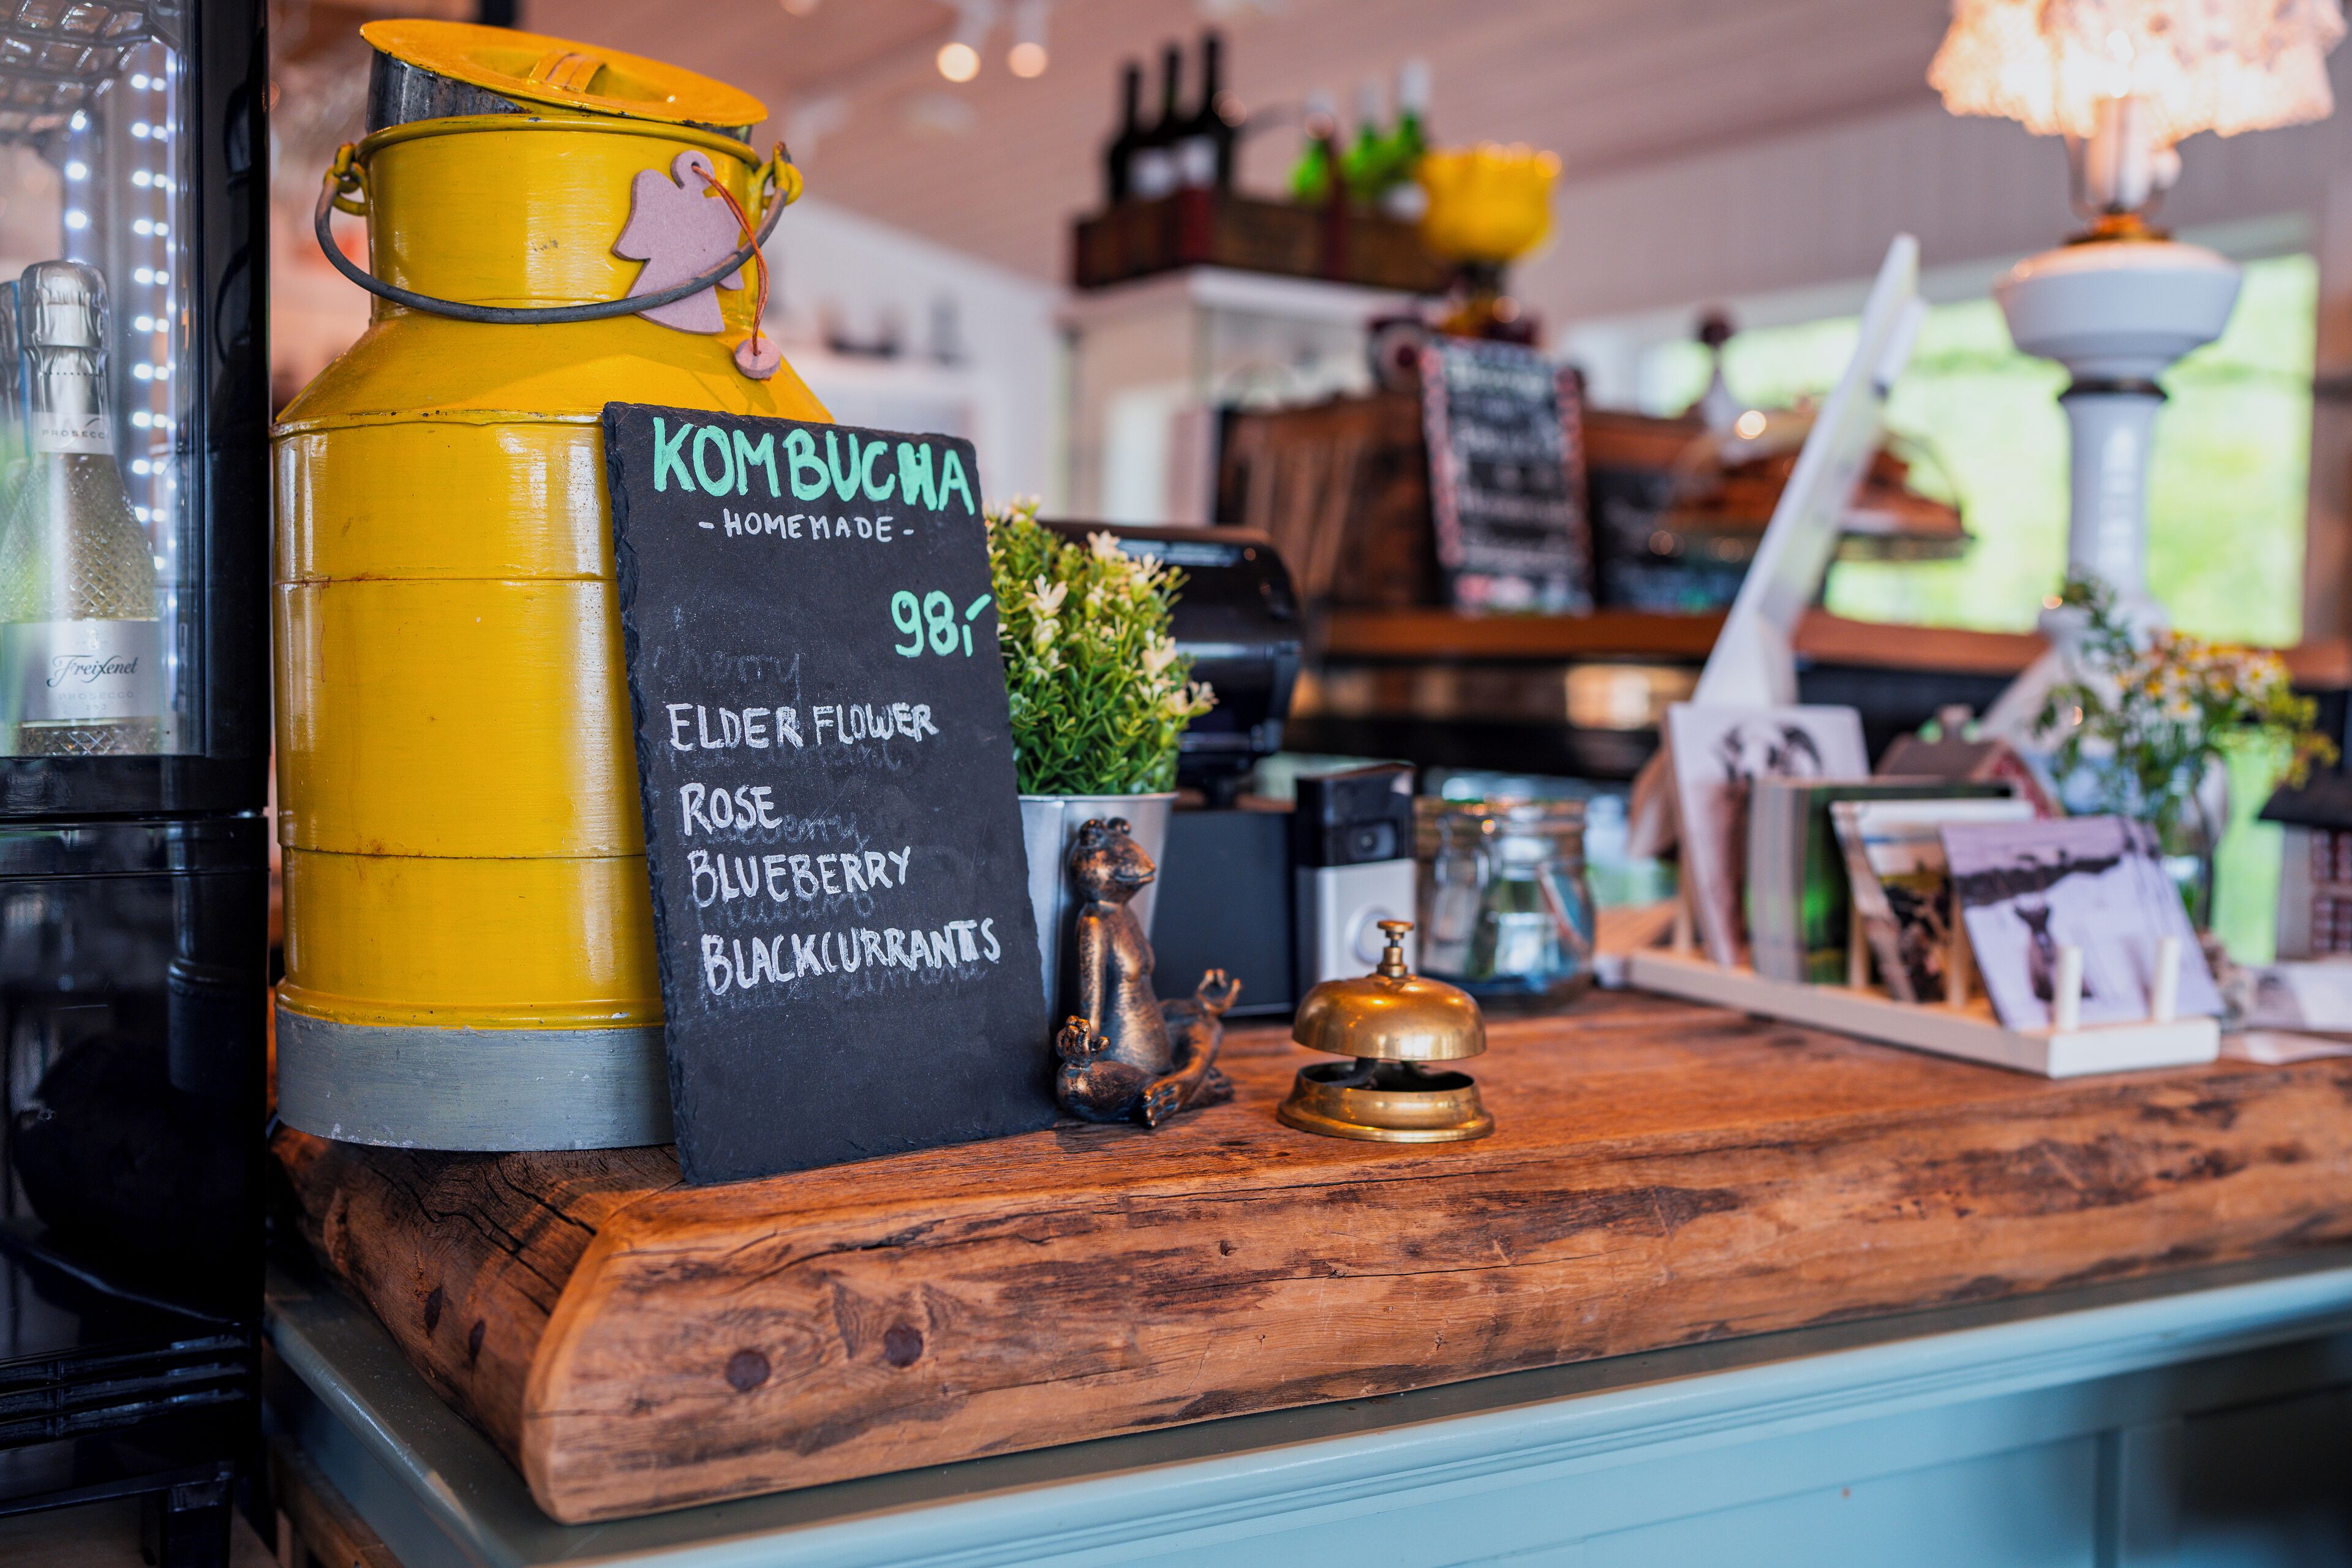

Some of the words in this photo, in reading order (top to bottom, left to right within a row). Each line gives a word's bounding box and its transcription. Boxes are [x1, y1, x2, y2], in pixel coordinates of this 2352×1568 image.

[653, 417, 976, 516] KOMBUCHA
[47, 655, 139, 688] Freixenet
[58, 691, 135, 701] PROSECCO
[665, 703, 804, 752] ELDER
[812, 702, 940, 745] FLOWER
[679, 782, 783, 837] ROSE
[687, 845, 911, 908] BLUEBERRY
[700, 916, 1002, 997] BLACKCURRANTS
